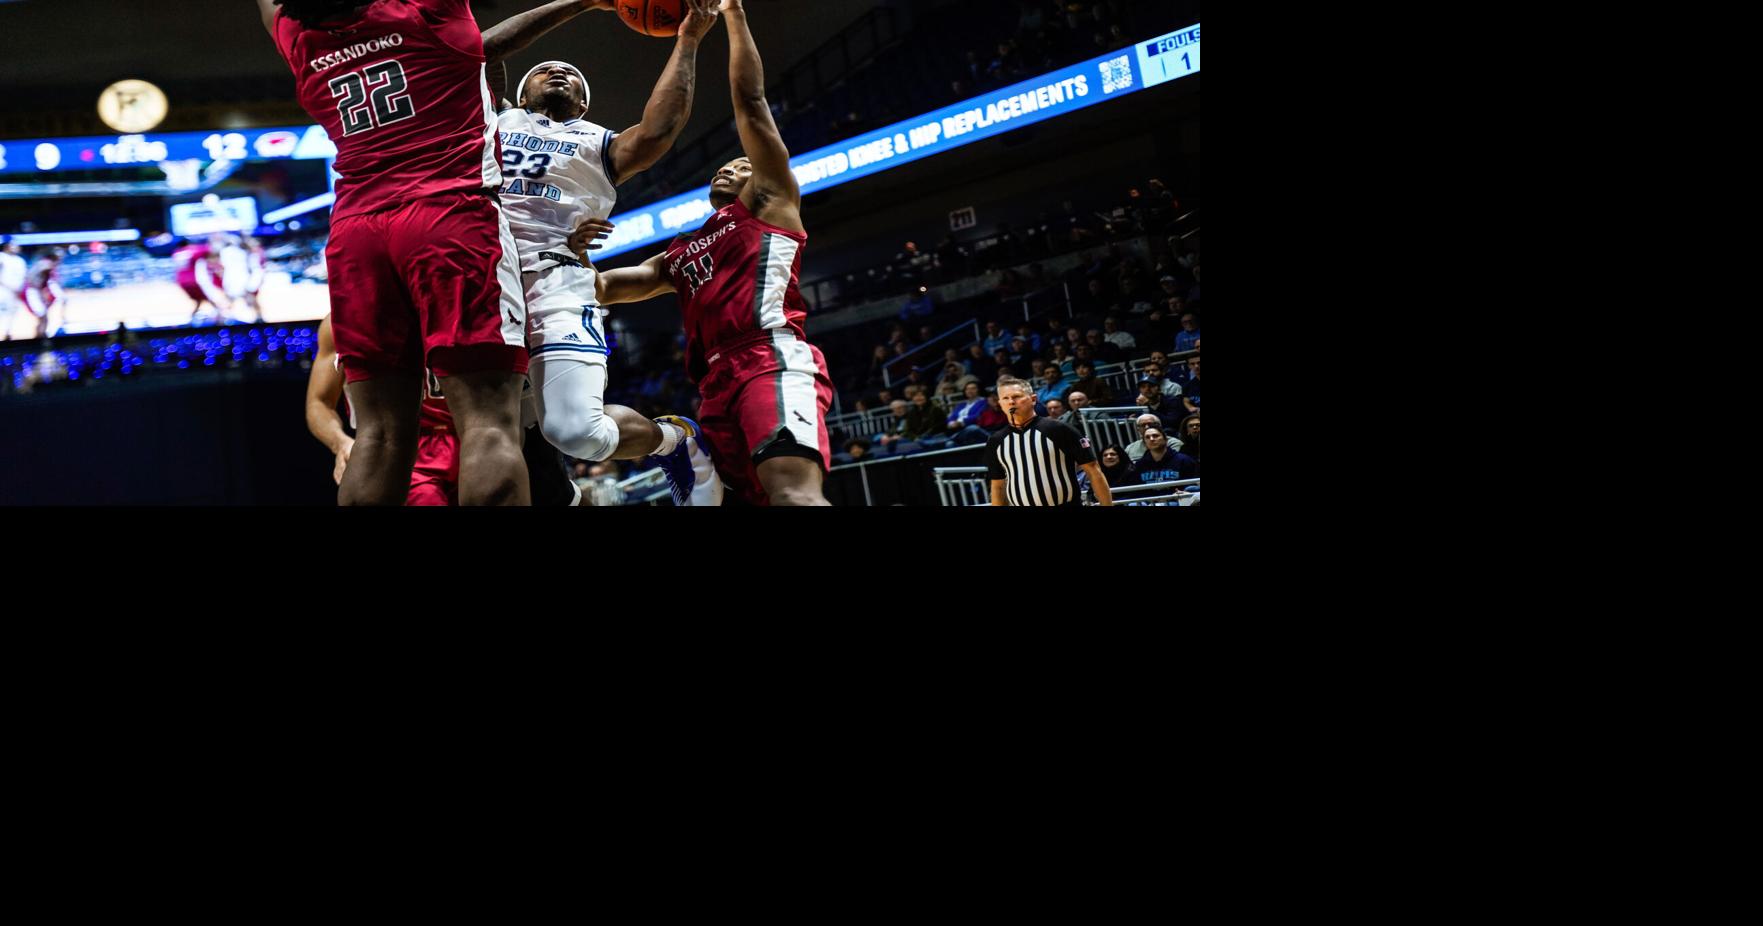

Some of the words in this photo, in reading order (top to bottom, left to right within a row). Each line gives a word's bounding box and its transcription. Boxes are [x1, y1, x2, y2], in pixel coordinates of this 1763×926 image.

[310, 33, 404, 72] ESSANDOKO
[1181, 52, 1191, 70] 1
[328, 59, 415, 137] 22
[941, 74, 1089, 138] REPLACEMENTS
[202, 133, 248, 160] 12
[502, 149, 552, 178] 23
[686, 221, 737, 258] JOSEPH'S
